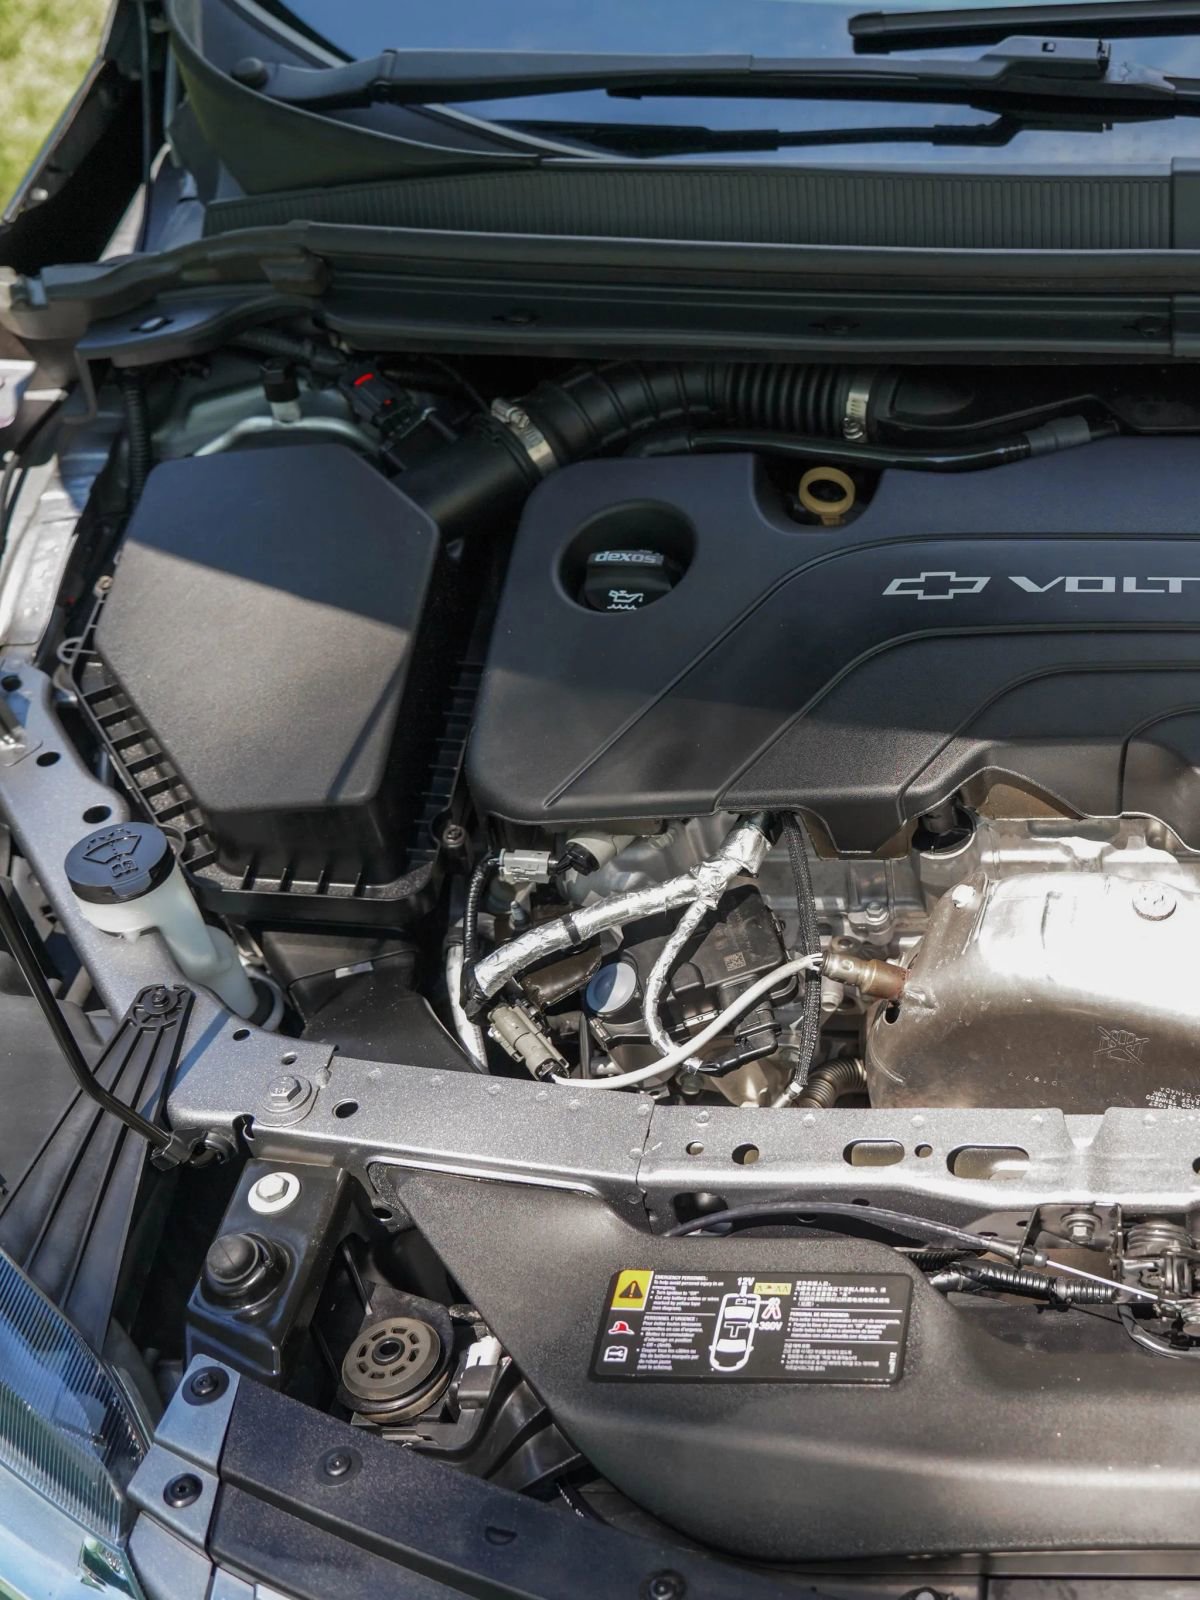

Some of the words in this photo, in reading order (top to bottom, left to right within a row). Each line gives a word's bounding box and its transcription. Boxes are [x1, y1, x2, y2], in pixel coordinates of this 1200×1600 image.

[594, 551, 656, 564] dexos
[1160, 1087, 1192, 1098] CANADA
[1145, 1094, 1177, 1106] TENNECO
[738, 1277, 755, 1286] 12V
